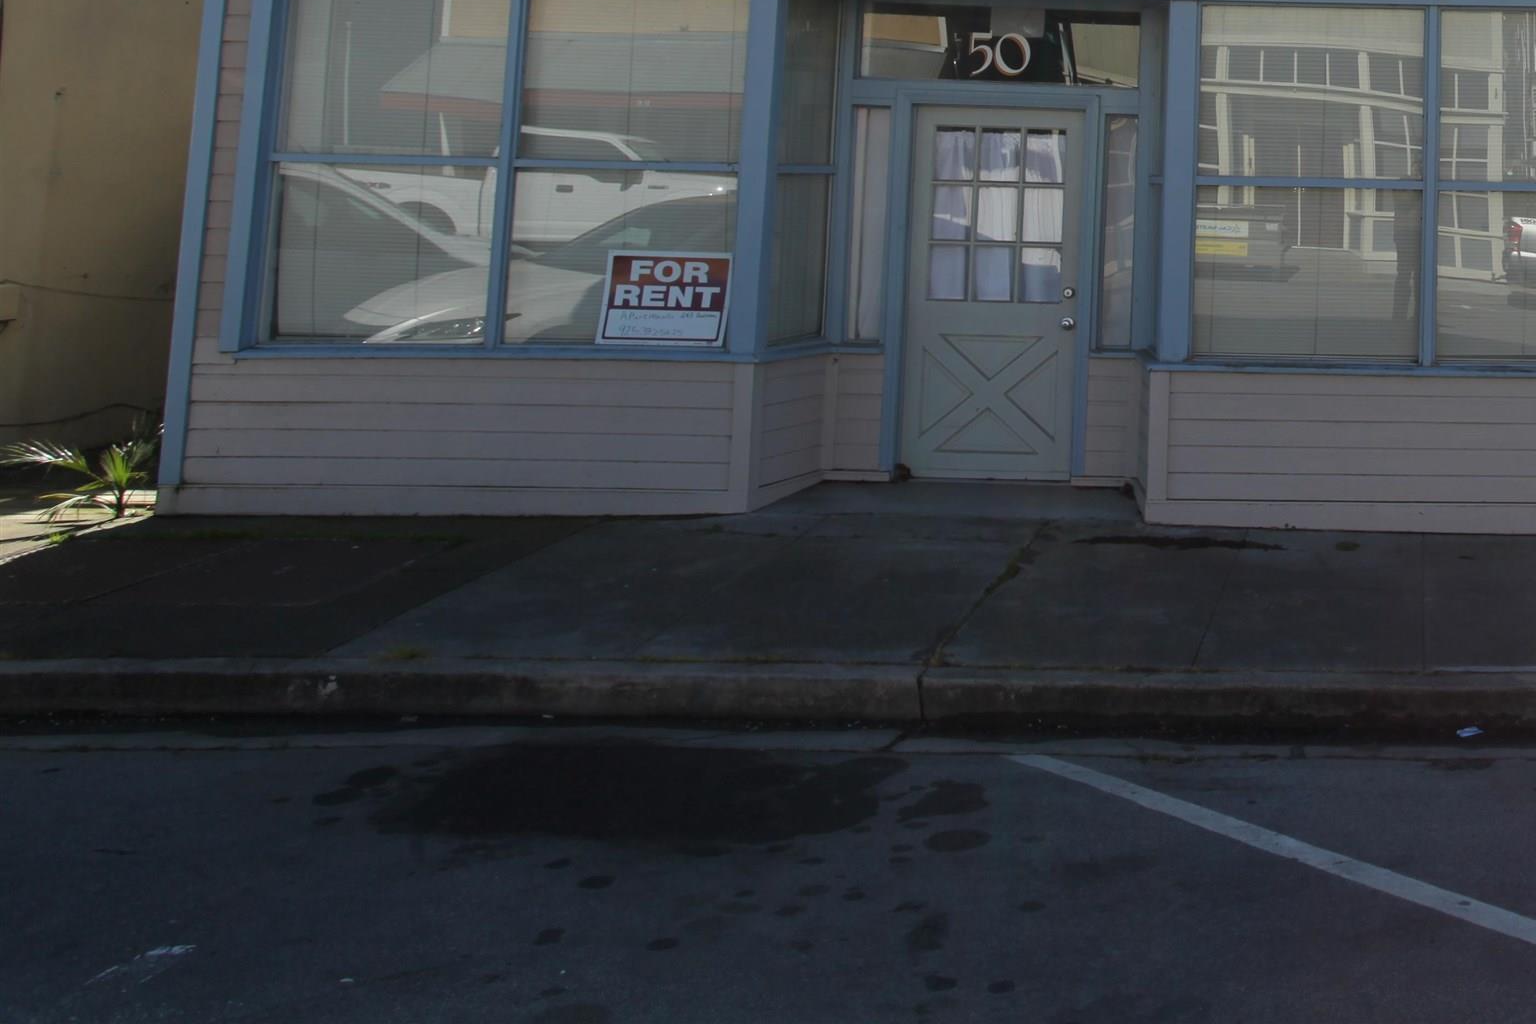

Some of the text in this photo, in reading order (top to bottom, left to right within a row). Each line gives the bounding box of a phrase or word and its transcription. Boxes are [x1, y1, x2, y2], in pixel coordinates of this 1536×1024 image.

[968, 29, 1032, 77] 50
[629, 259, 710, 284] FOR
[613, 284, 721, 309] RENT
